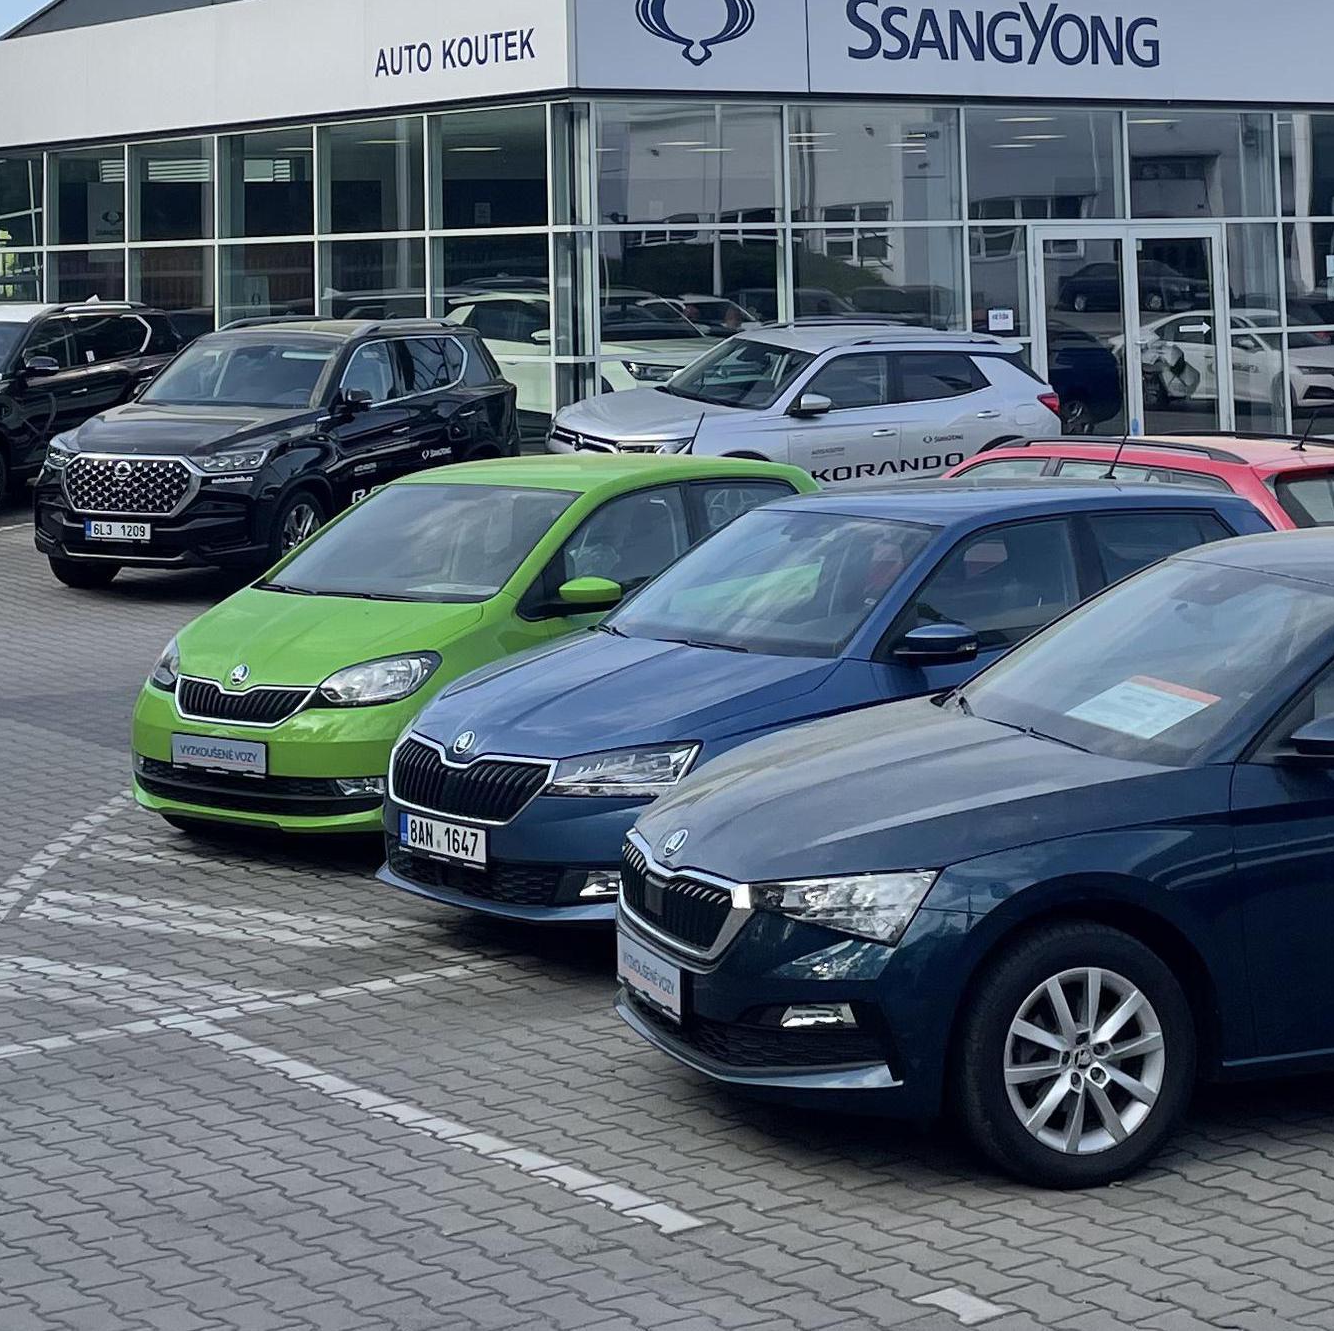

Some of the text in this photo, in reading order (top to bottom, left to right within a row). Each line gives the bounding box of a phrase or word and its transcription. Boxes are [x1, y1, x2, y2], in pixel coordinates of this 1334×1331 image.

[375, 27, 536, 78] AUTO KOUTEK
[812, 453, 964, 482] KORANDO
[94, 523, 146, 537] 6L3 1209
[180, 744, 258, 763] VYZKOUŠENÉ VOZY
[410, 819, 479, 857] 8AN 1647
